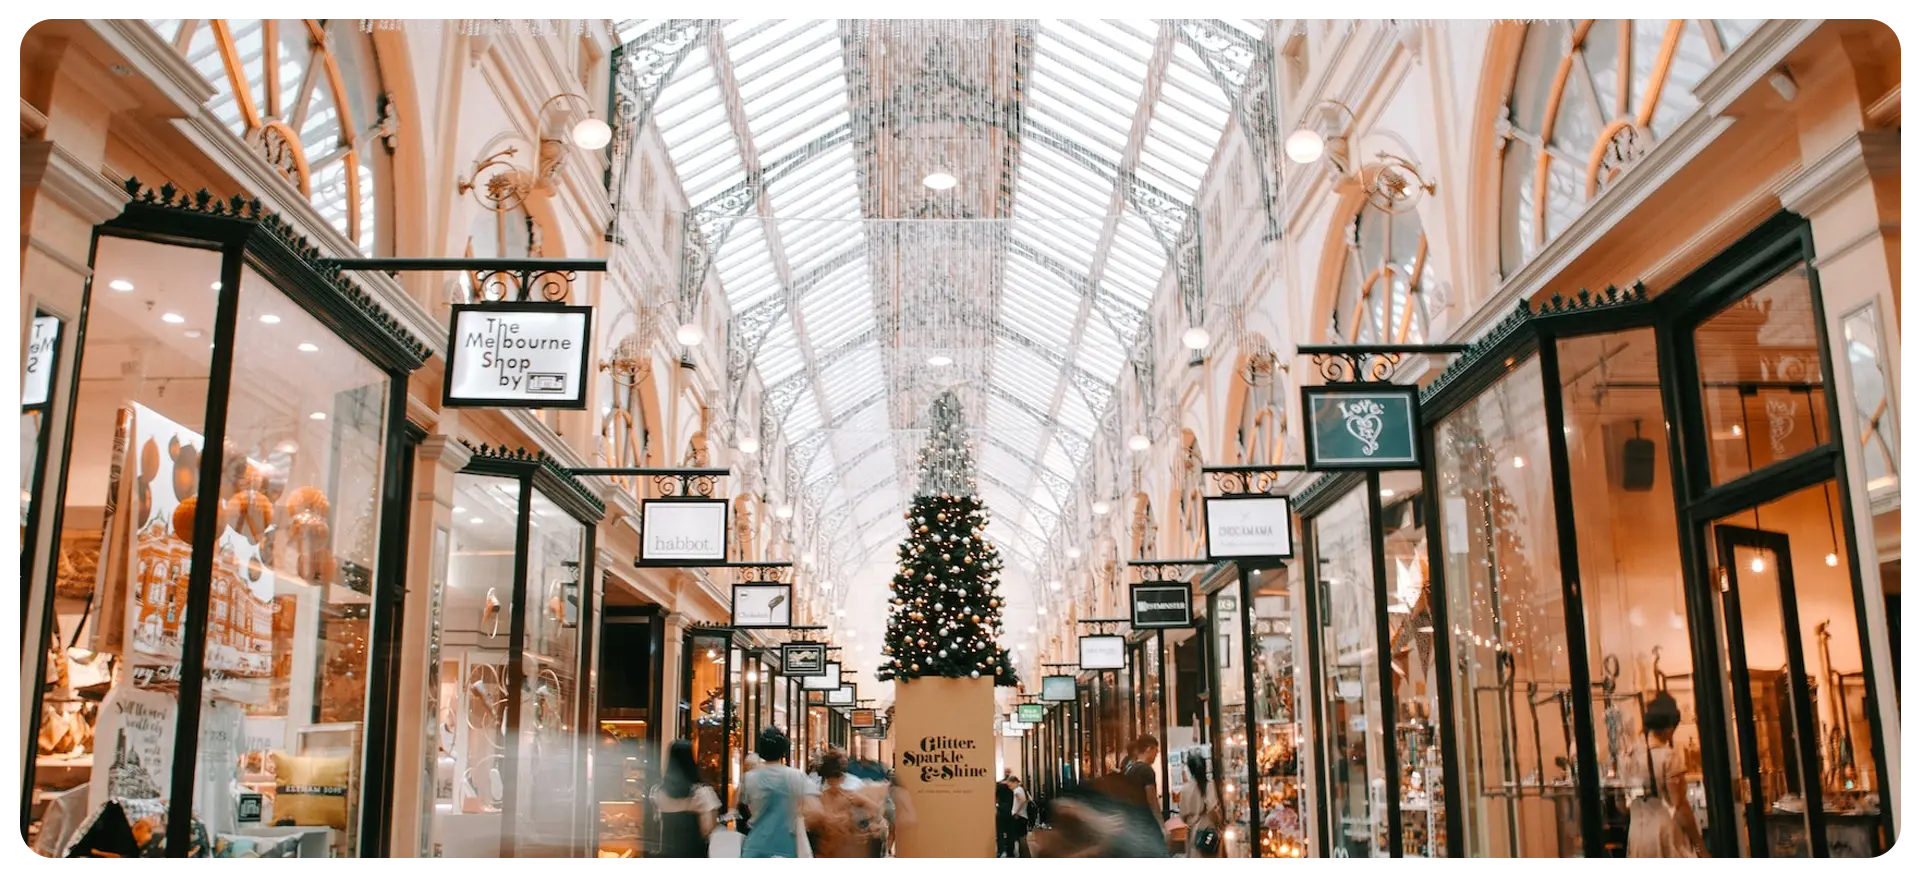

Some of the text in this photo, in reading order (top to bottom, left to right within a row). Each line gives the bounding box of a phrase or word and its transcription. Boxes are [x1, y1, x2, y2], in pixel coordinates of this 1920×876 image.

[487, 318, 519, 334] The
[465, 332, 571, 350] Melbourne
[481, 351, 530, 373] Shop
[500, 375, 522, 391] by
[655, 536, 713, 551] habbot.
[920, 736, 976, 753] Glitter.
[903, 750, 964, 767] Sparkle
